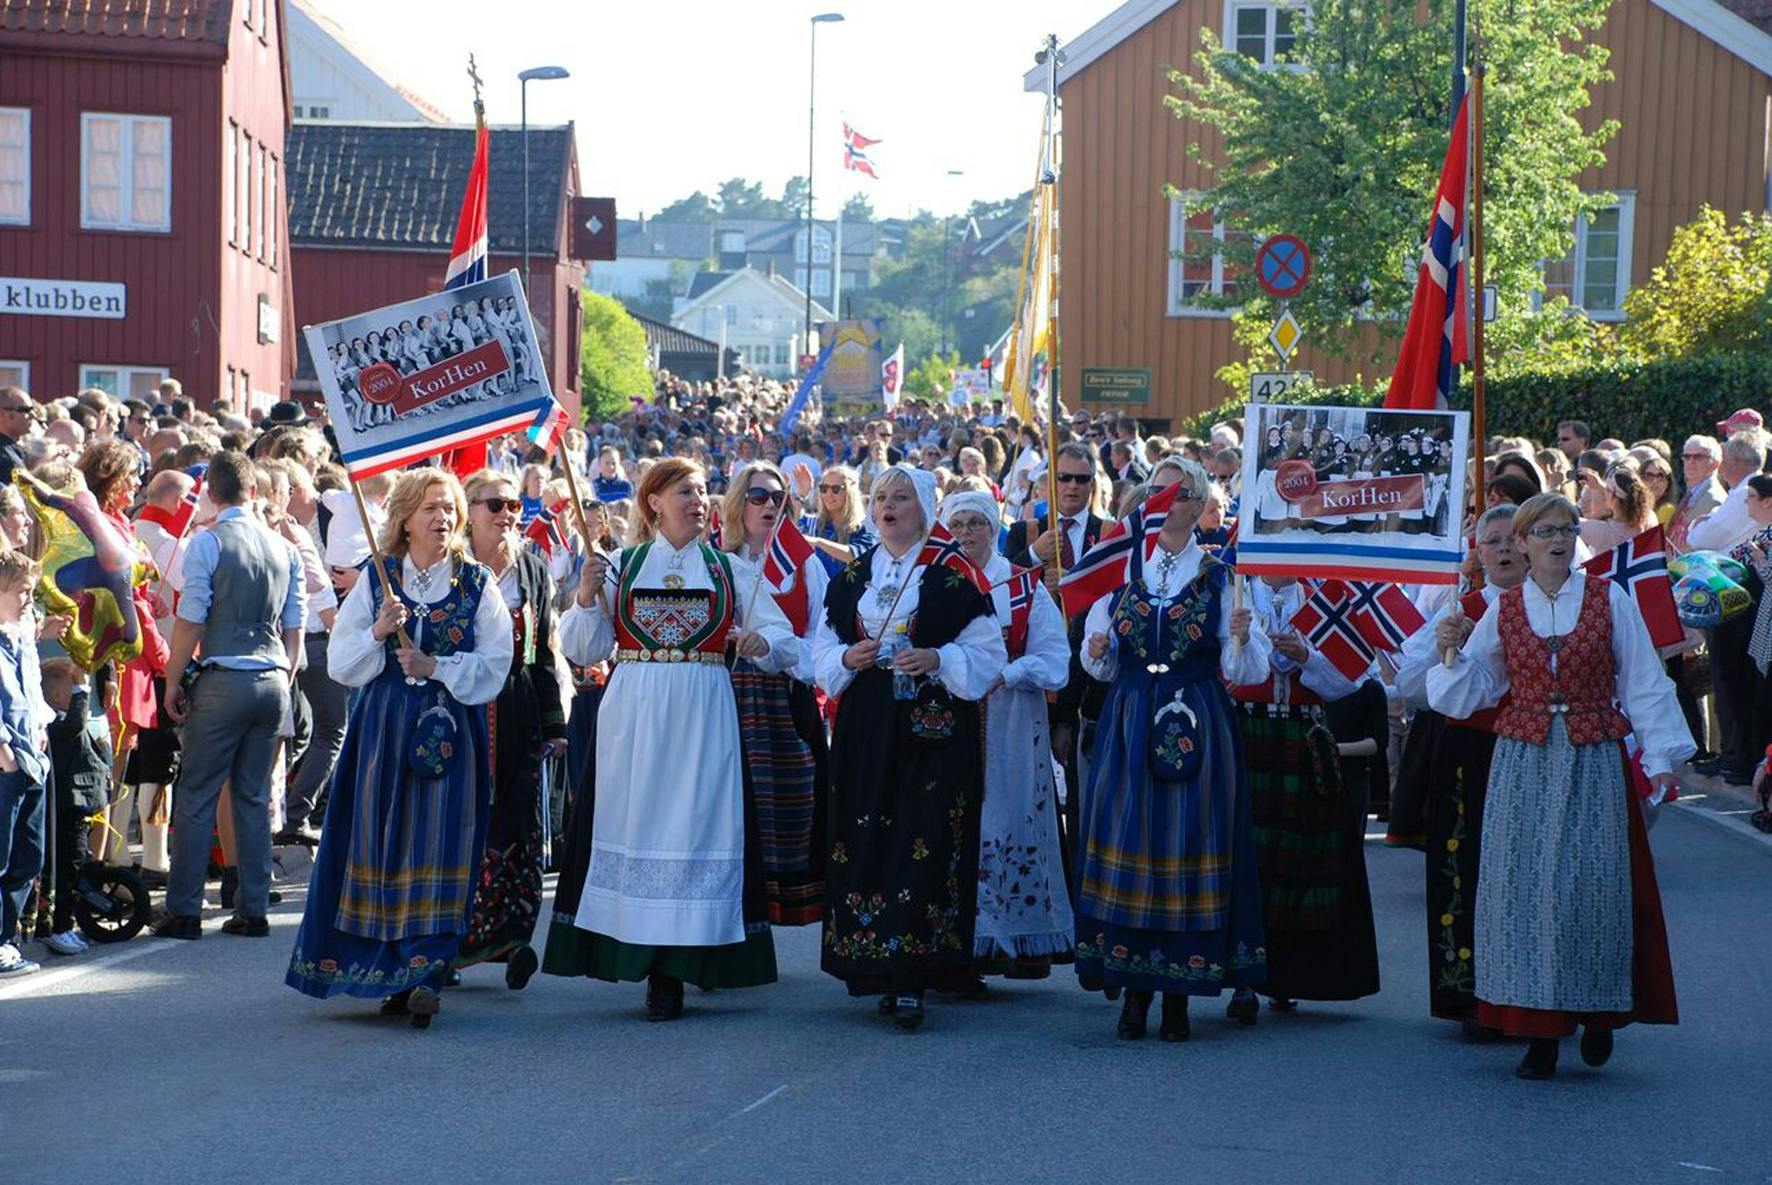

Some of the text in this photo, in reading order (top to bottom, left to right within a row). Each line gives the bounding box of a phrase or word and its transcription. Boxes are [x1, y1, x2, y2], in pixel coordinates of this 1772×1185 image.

[6, 285, 121, 312] klubben
[409, 360, 488, 399] KorHen
[1258, 379, 1304, 401] 42
[1321, 486, 1402, 508] KorHen
